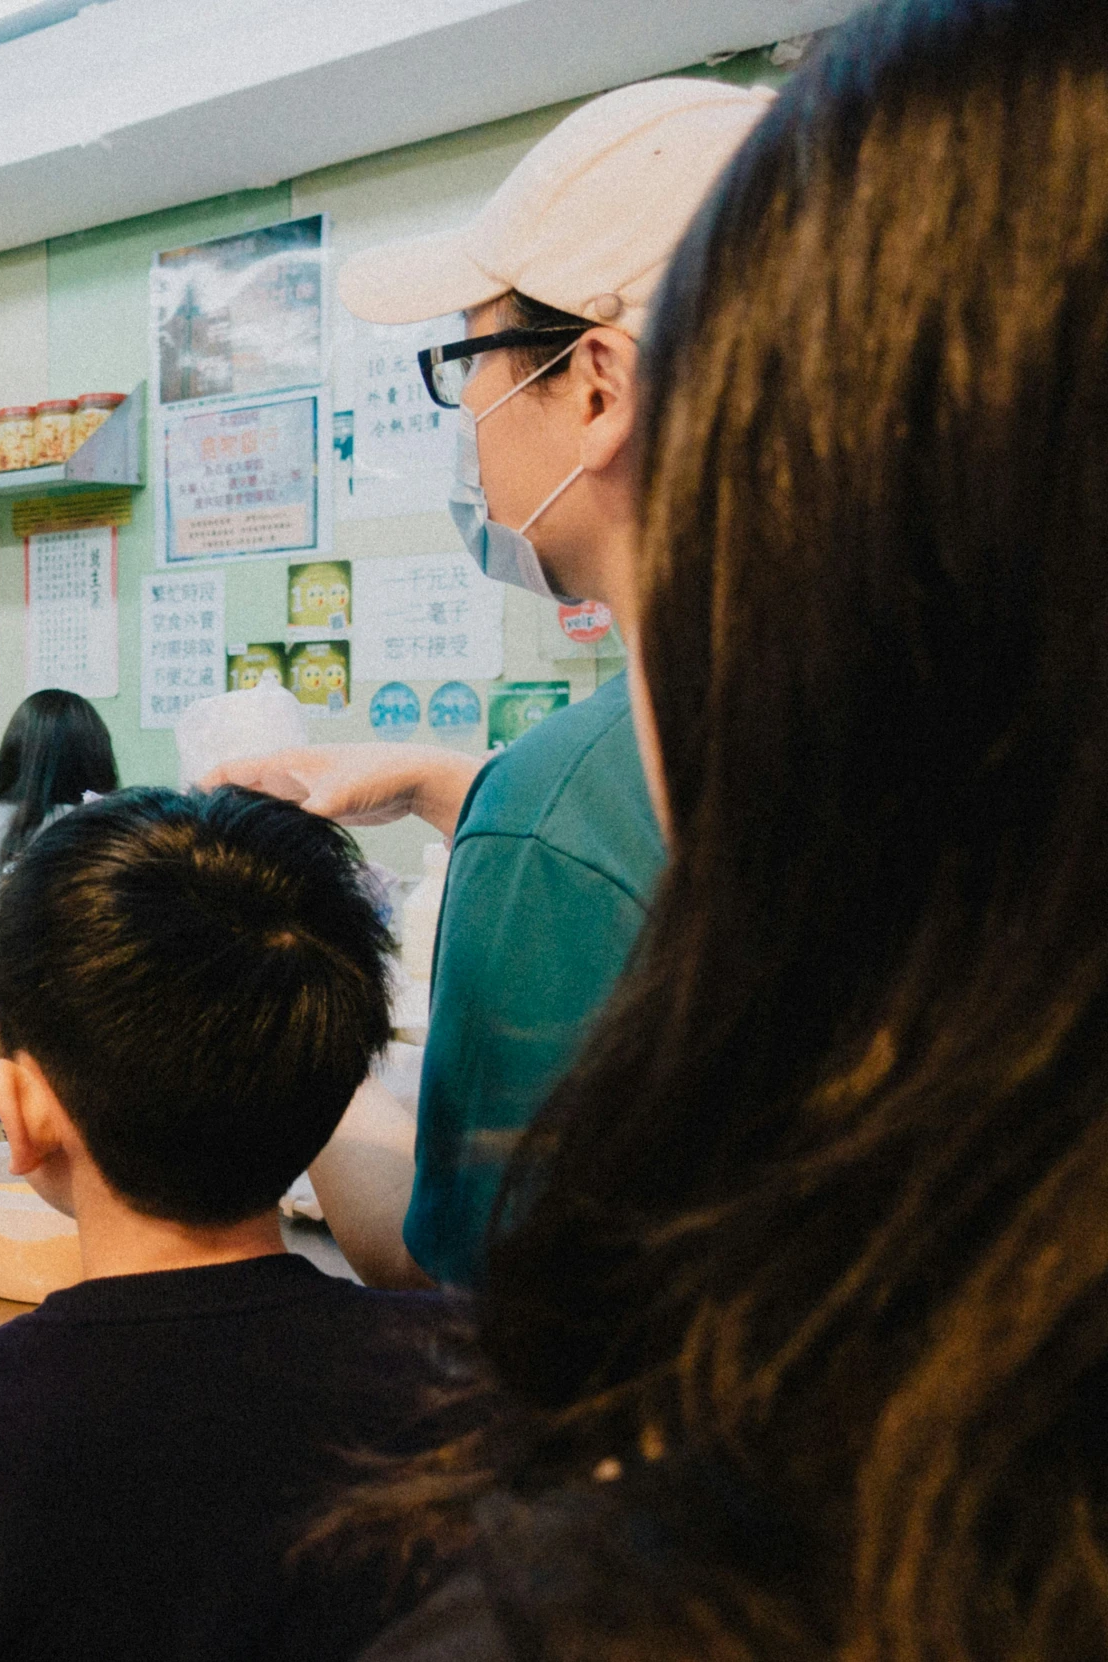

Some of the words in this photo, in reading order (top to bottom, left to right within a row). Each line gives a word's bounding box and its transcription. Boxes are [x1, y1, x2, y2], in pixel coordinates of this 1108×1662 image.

[566, 614, 595, 630] yelp
[383, 633, 469, 659] 恕不接受
